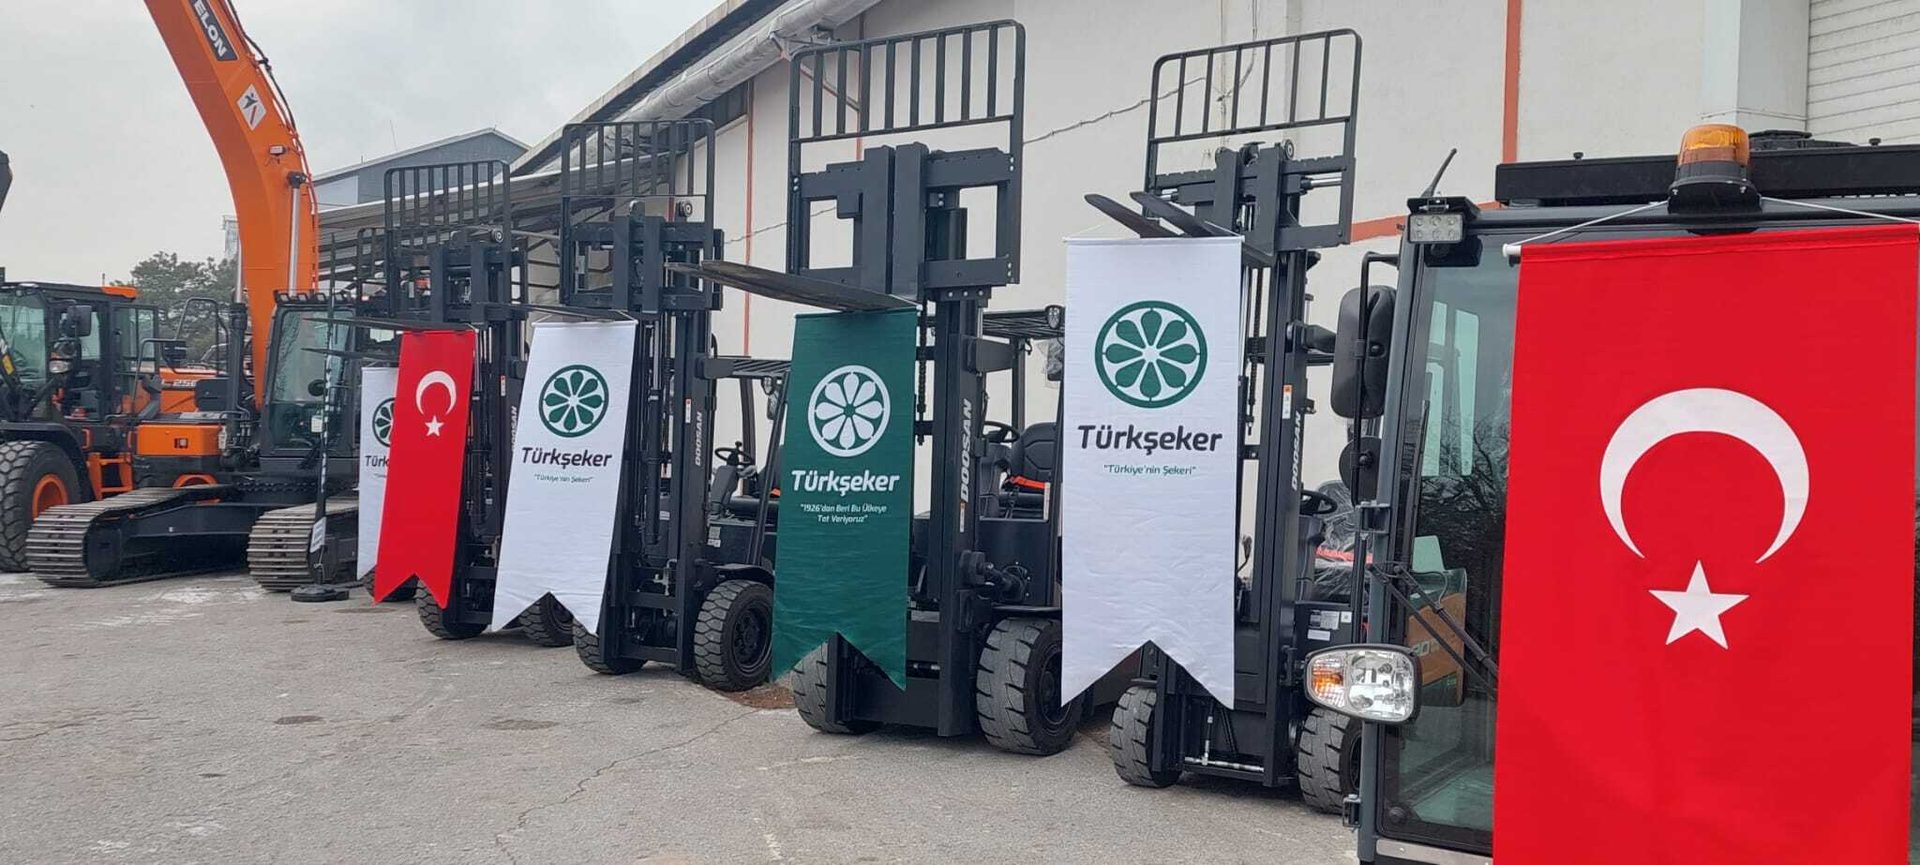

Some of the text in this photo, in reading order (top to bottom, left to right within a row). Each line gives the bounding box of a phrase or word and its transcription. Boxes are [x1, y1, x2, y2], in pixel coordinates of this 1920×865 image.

[961, 398, 972, 503] DOOSAN
[1077, 424, 1223, 456] Türkşeker
[1291, 410, 1301, 491] DOOSAN
[522, 446, 613, 470] Türkşeker
[791, 469, 900, 497] Türkşeker
[851, 503, 861, 512] Bu
